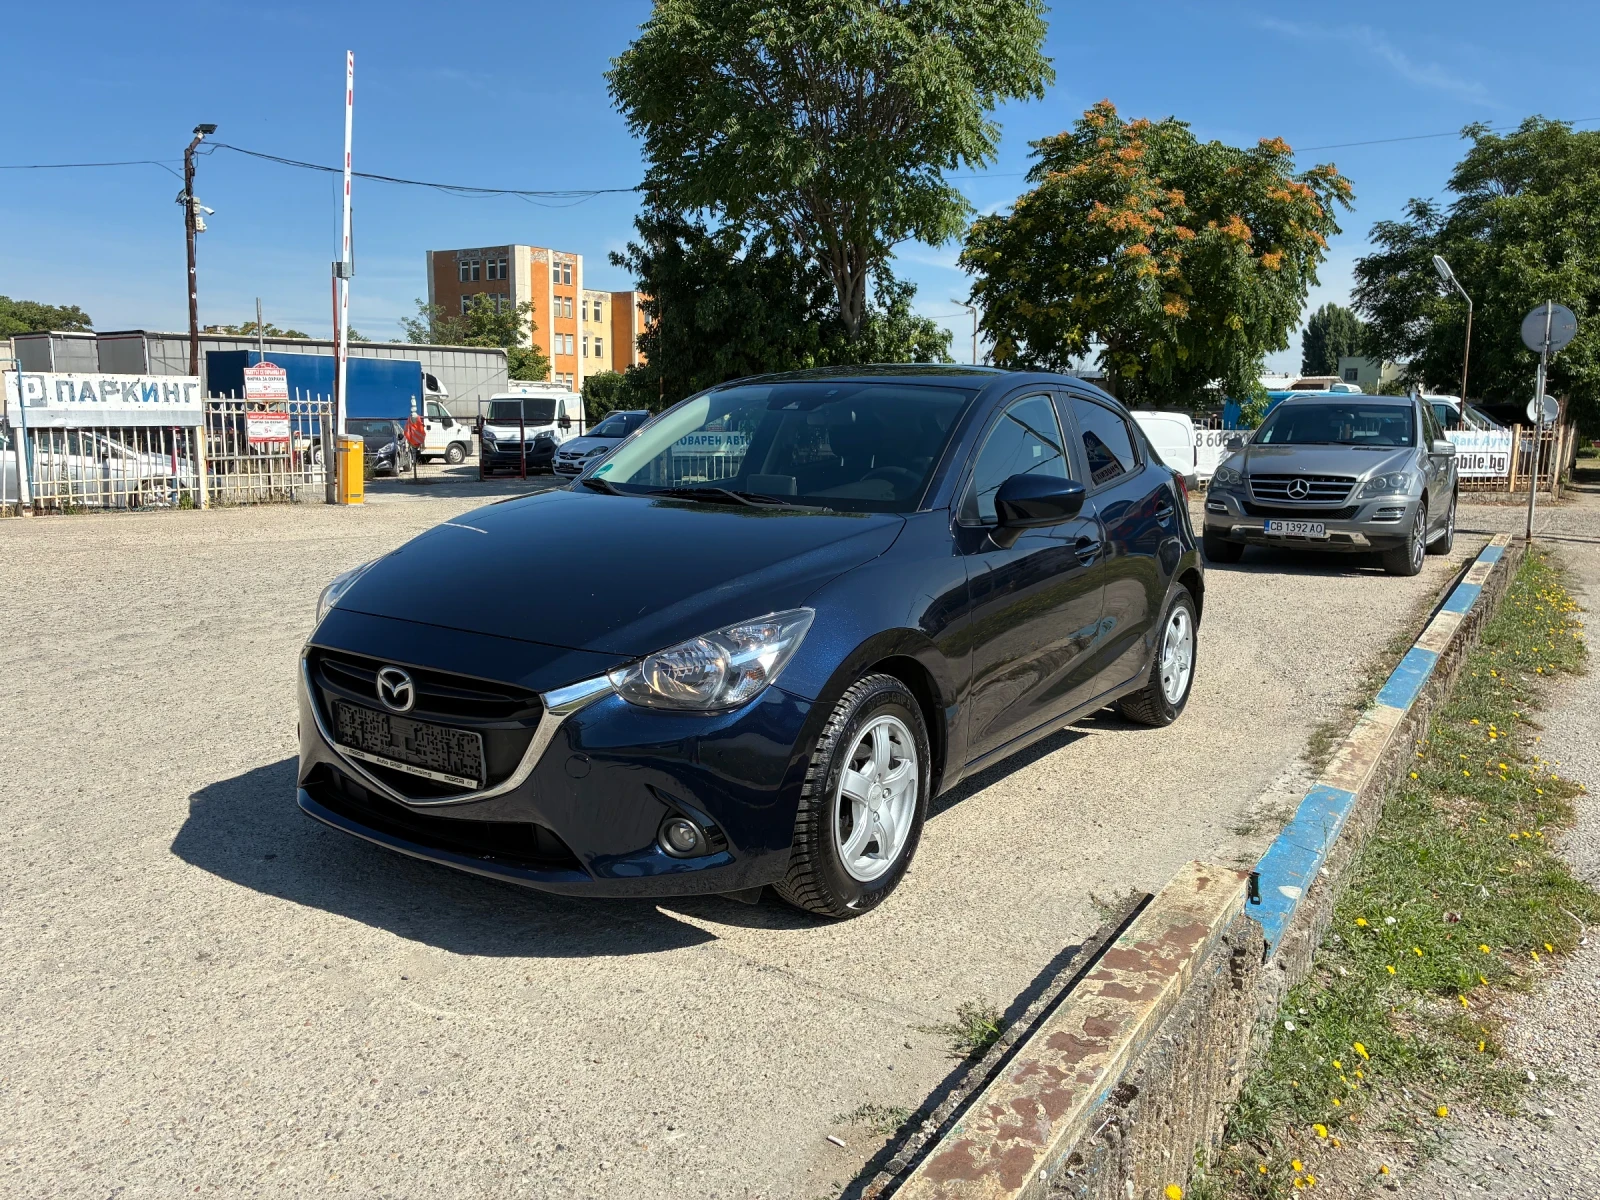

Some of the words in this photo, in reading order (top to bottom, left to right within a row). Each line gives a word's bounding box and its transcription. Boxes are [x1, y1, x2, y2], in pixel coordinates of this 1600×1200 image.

[56, 380, 197, 403] ПАРКИНГ
[1195, 432, 1203, 448] 8
[1482, 434, 1510, 448] Ауто
[1286, 522, 1308, 533] 1392
